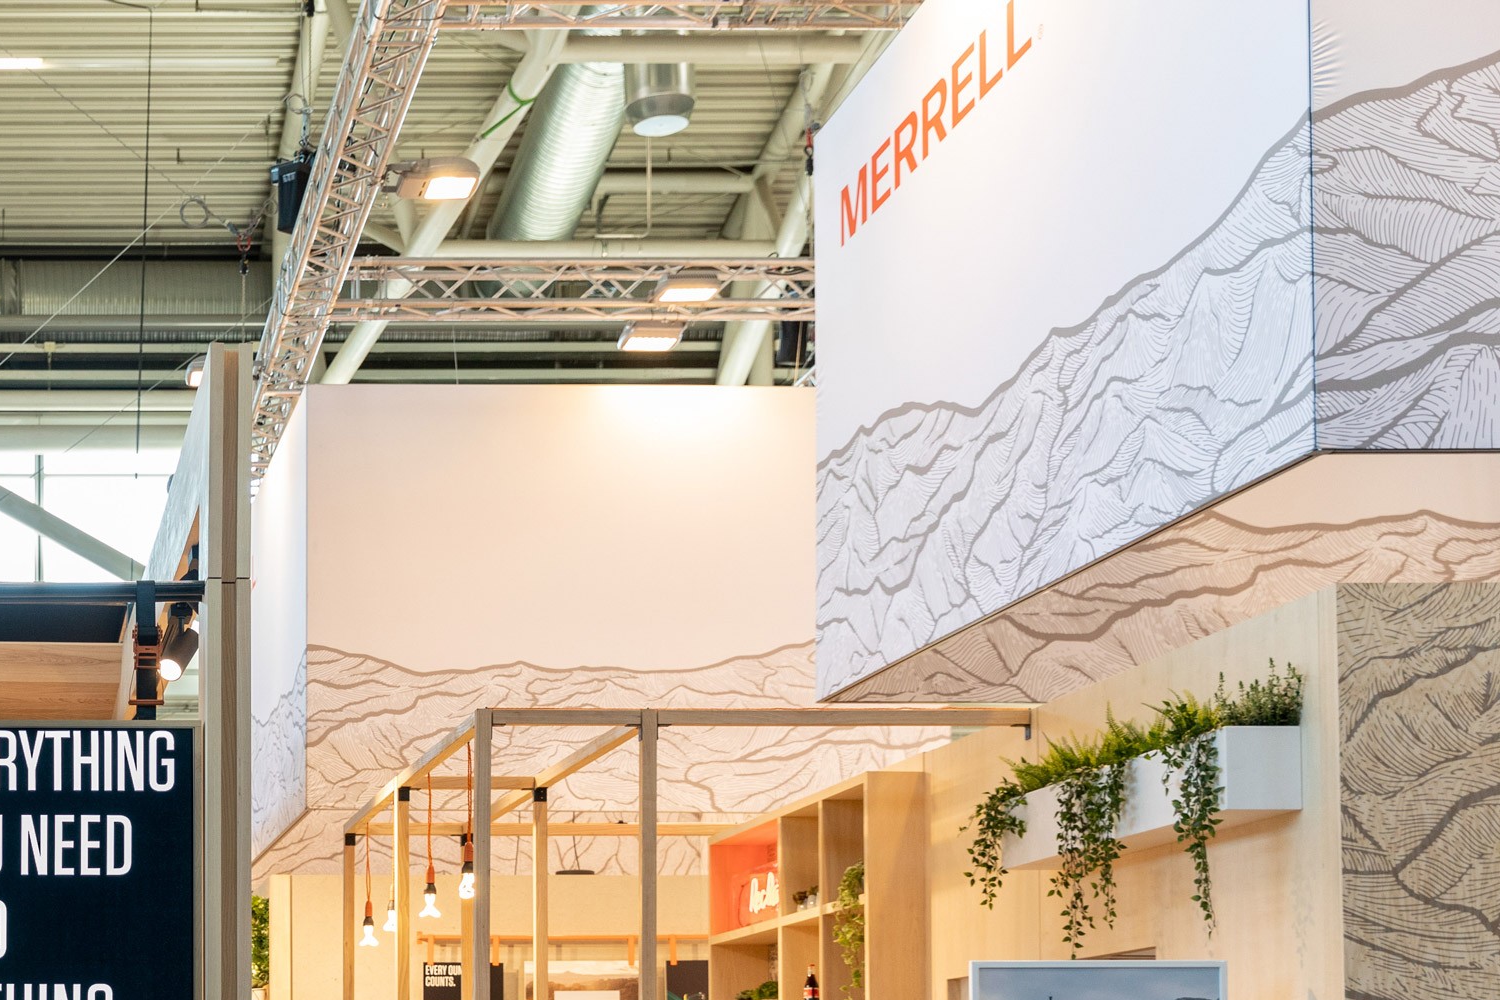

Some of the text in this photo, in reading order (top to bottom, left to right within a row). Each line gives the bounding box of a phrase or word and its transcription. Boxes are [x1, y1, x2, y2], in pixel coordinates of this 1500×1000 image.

[841, 0, 1032, 248] MERRELL
[20, 813, 132, 876] NEED
[425, 965, 447, 976] EVERY
[425, 976, 456, 987] COUNTS.
